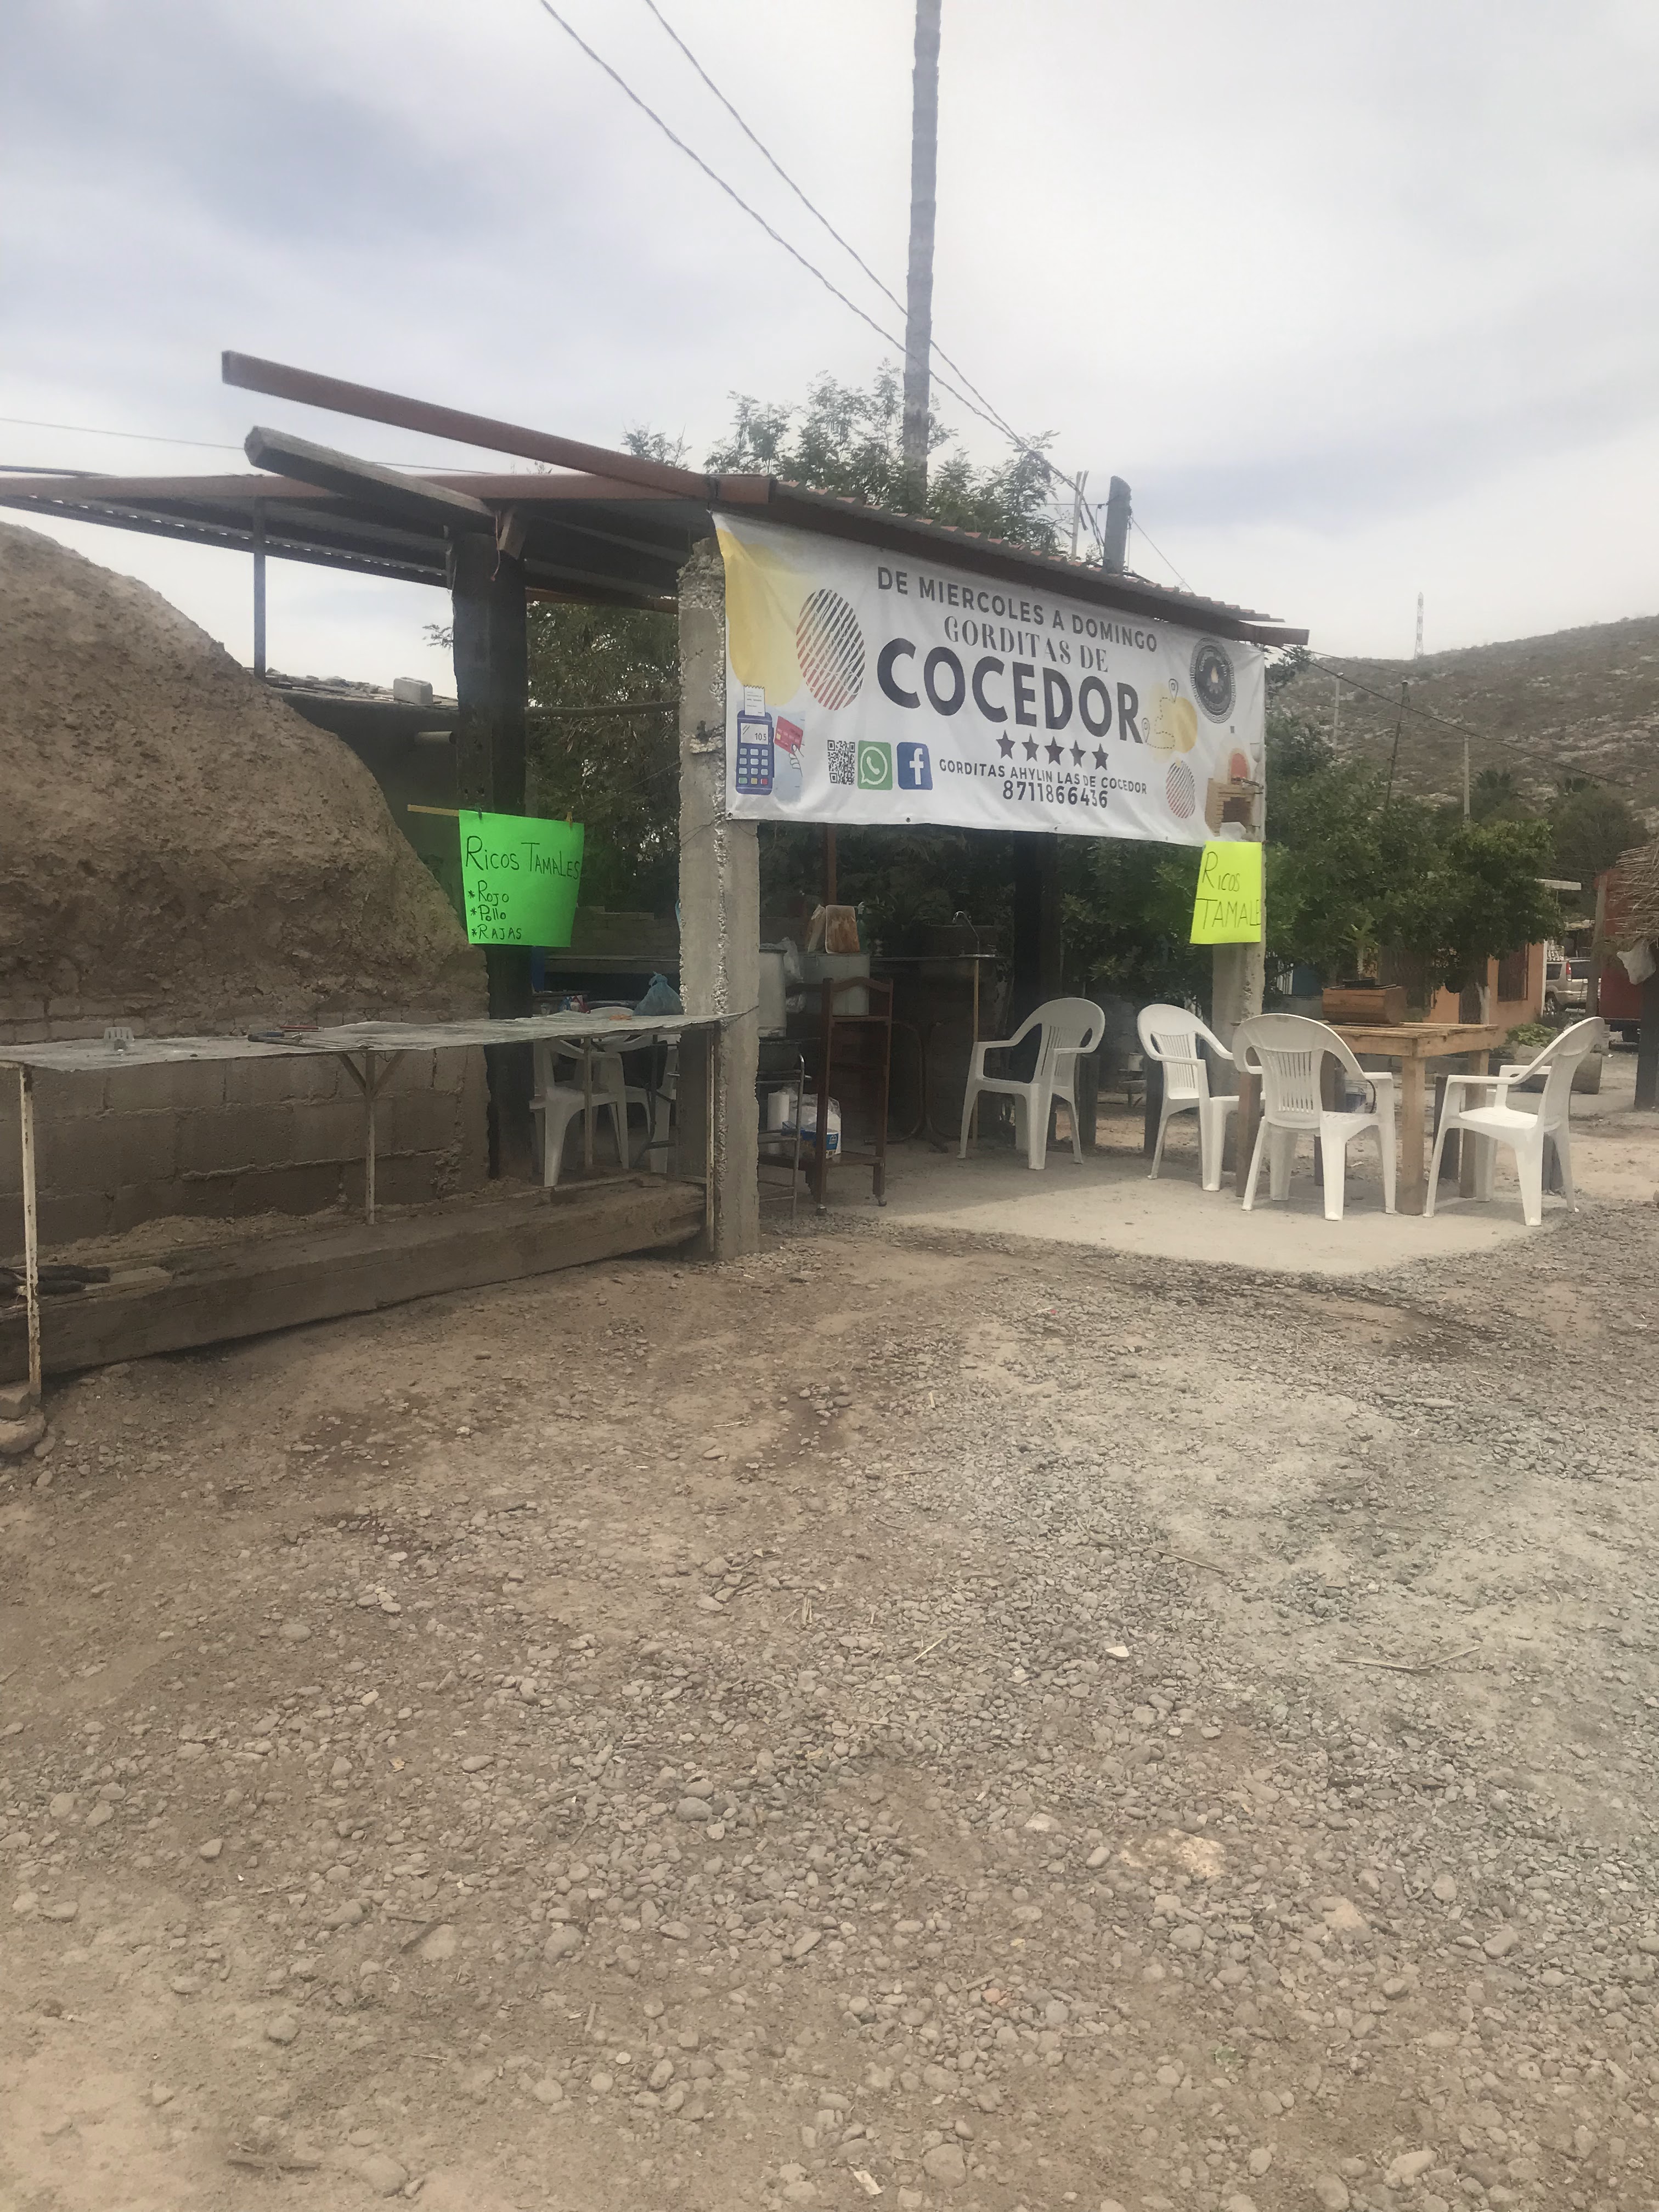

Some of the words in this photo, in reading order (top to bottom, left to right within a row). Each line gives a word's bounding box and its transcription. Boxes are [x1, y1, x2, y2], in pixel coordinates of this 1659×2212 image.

[878, 567, 908, 595] DE
[919, 577, 1043, 625] MIERCOLES
[1052, 610, 1064, 630] A
[1072, 614, 1157, 652] DOMINGO
[944, 616, 1071, 664] GORDITAS
[1080, 645, 1108, 673] DE
[877, 637, 1144, 744] COCEDOR
[939, 759, 1005, 777] GORDITAS
[1010, 766, 1053, 782] AHYLIN
[1057, 772, 1080, 785] LAS
[1083, 775, 1096, 788] DE
[1101, 777, 1147, 794] COCEDOR
[1003, 780, 1108, 809] 8711866436
